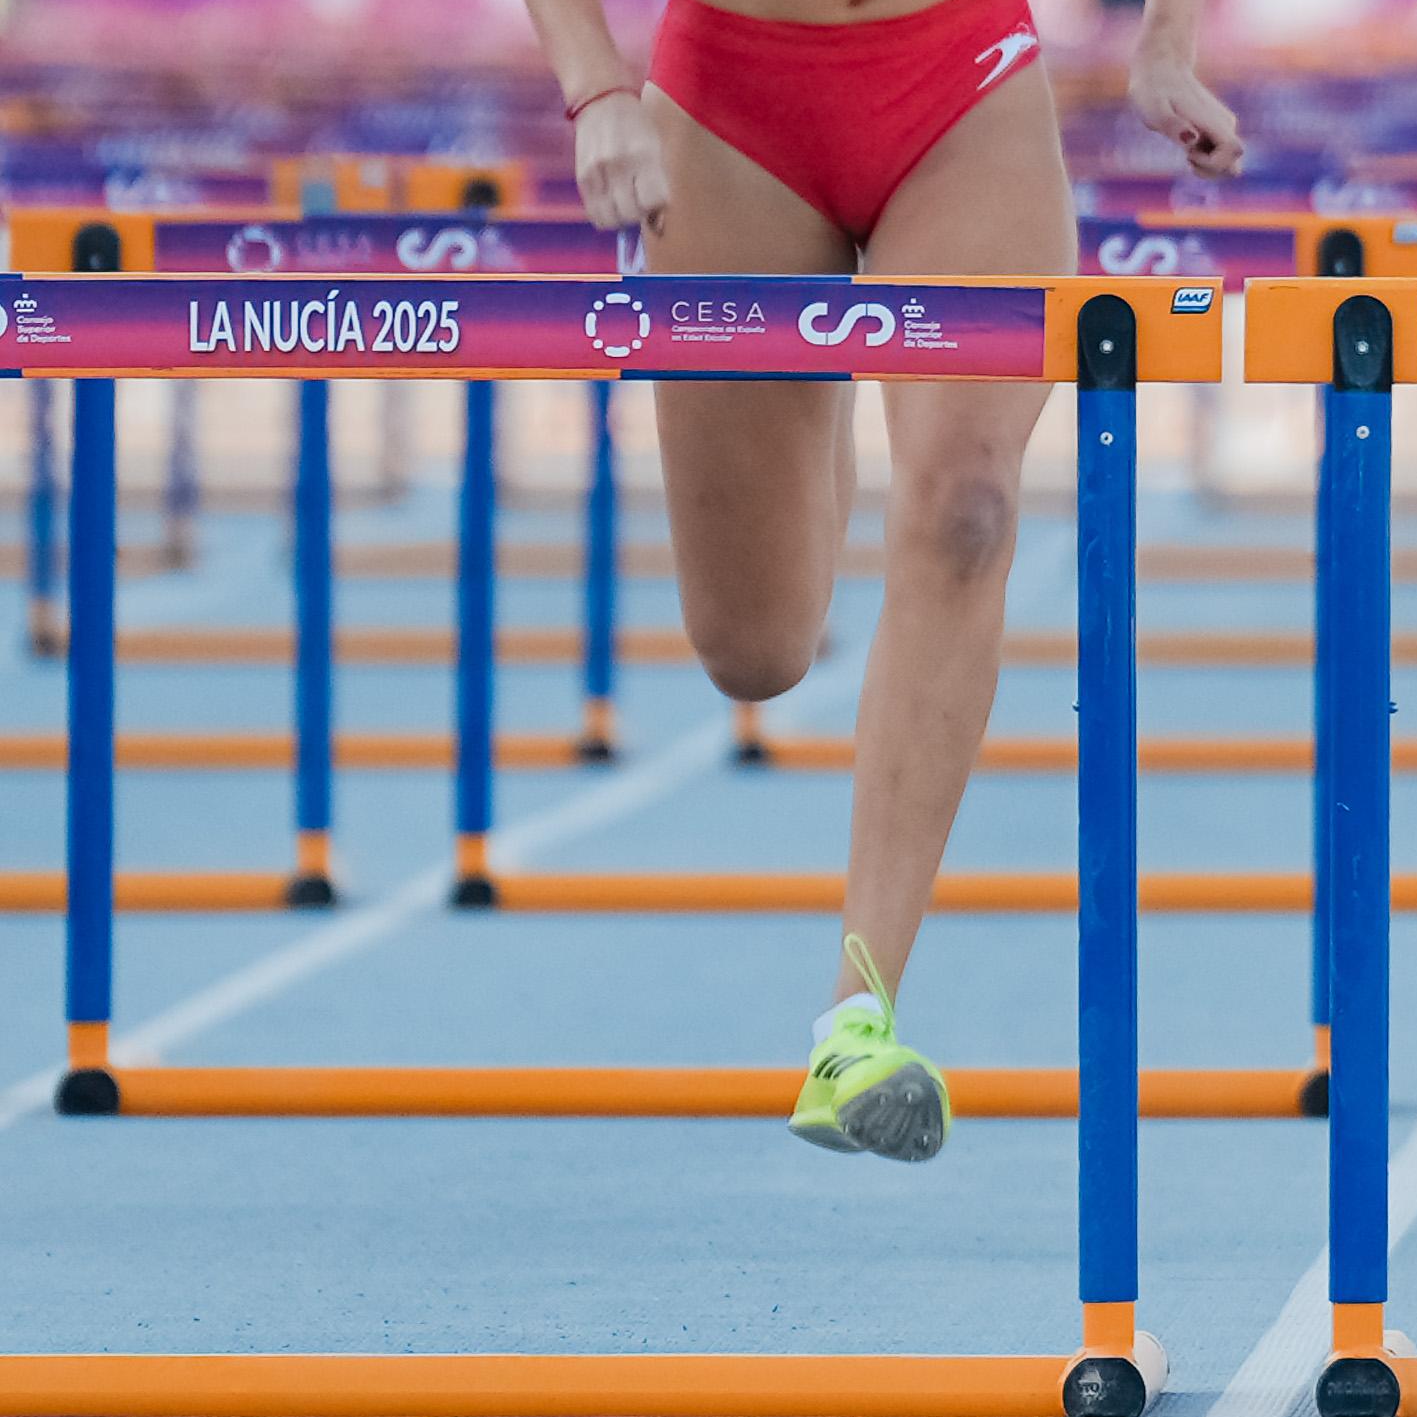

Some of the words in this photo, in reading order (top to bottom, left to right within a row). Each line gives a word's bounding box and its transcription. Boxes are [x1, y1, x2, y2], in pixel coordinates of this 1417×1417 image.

[1177, 292, 1209, 303] IAAF
[190, 301, 236, 351] LA
[244, 290, 365, 352] NUCÍA
[372, 300, 459, 352] 2025
[671, 301, 766, 322] CESA
